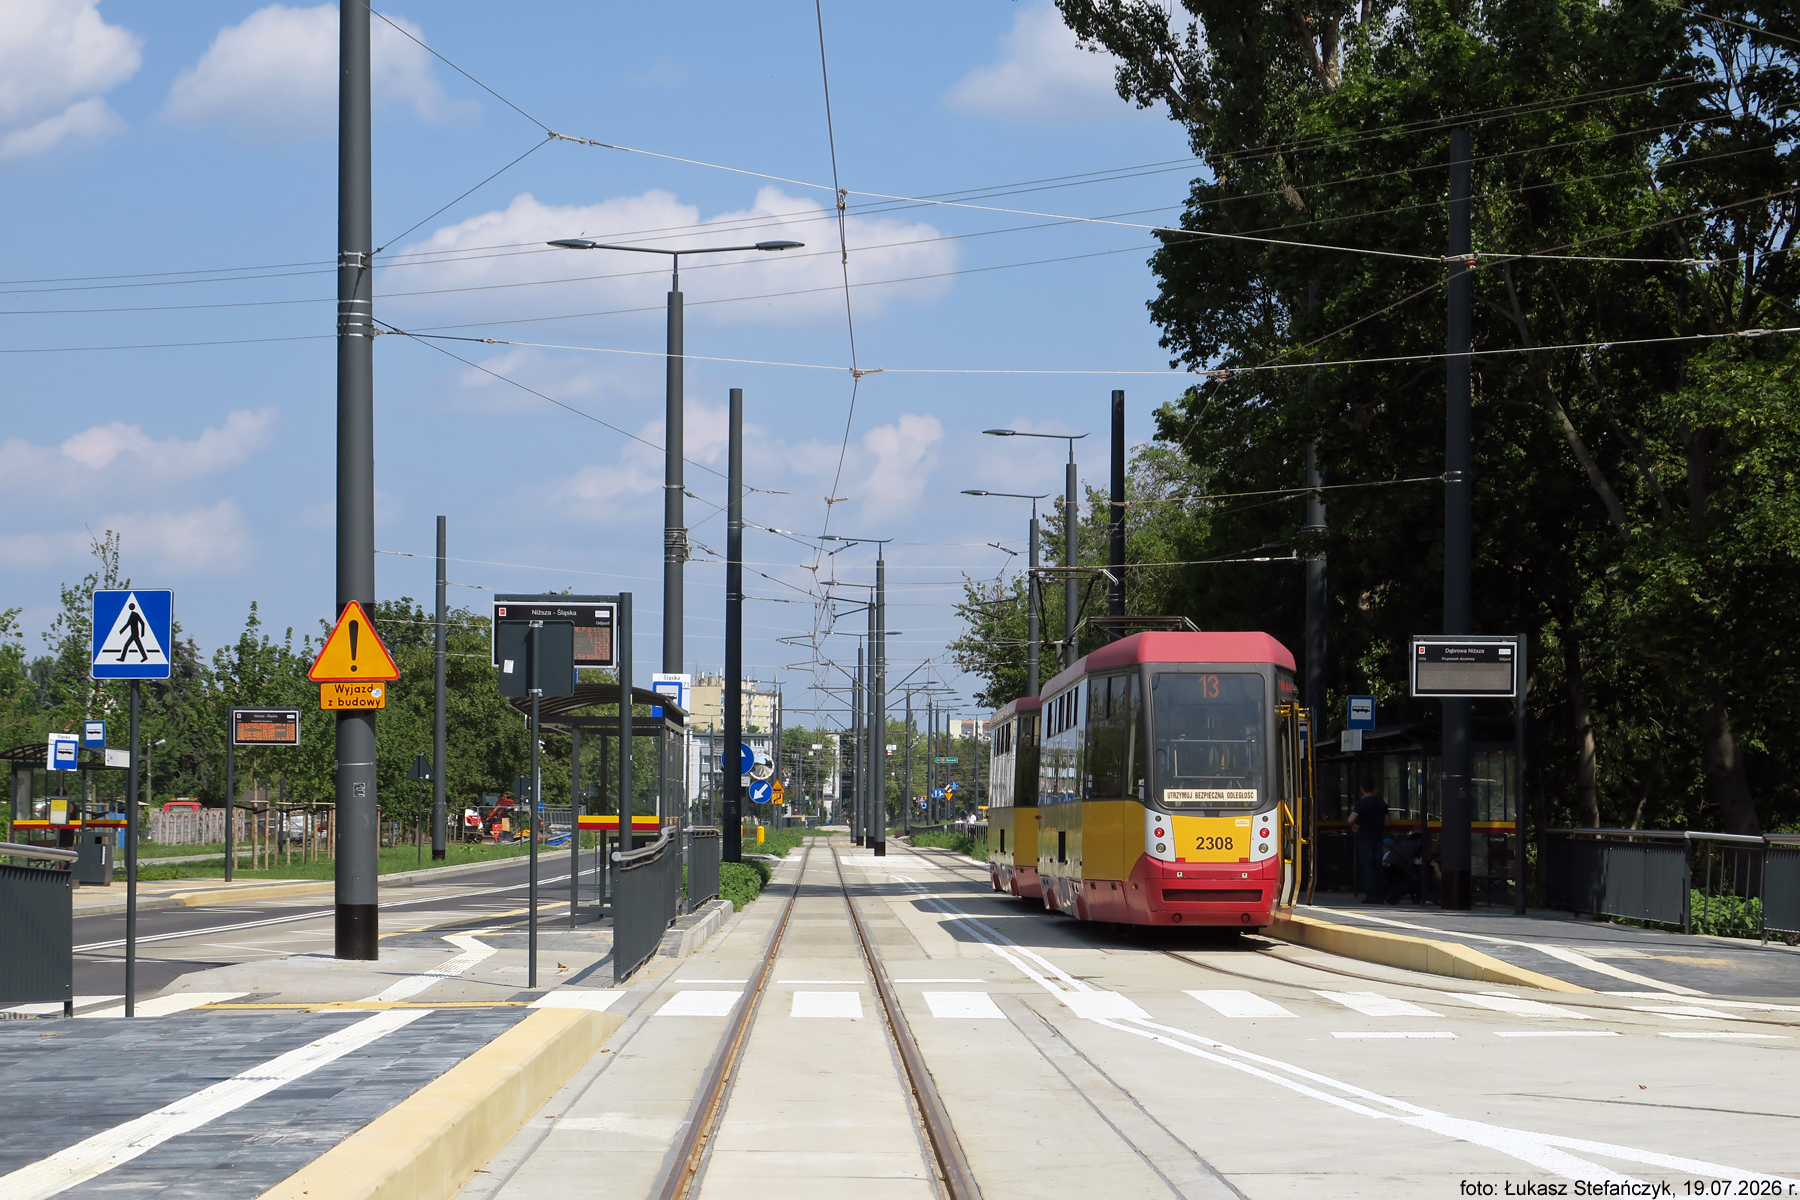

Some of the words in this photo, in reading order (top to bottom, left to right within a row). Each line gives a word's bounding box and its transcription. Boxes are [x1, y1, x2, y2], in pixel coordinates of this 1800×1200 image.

[556, 608, 577, 617] Śląska
[334, 684, 374, 696] Wyjazd
[1198, 675, 1220, 698] 13
[338, 697, 380, 708] budowy
[1195, 791, 1224, 800] BEZPIECZNĄ
[1196, 836, 1234, 850] 2308
